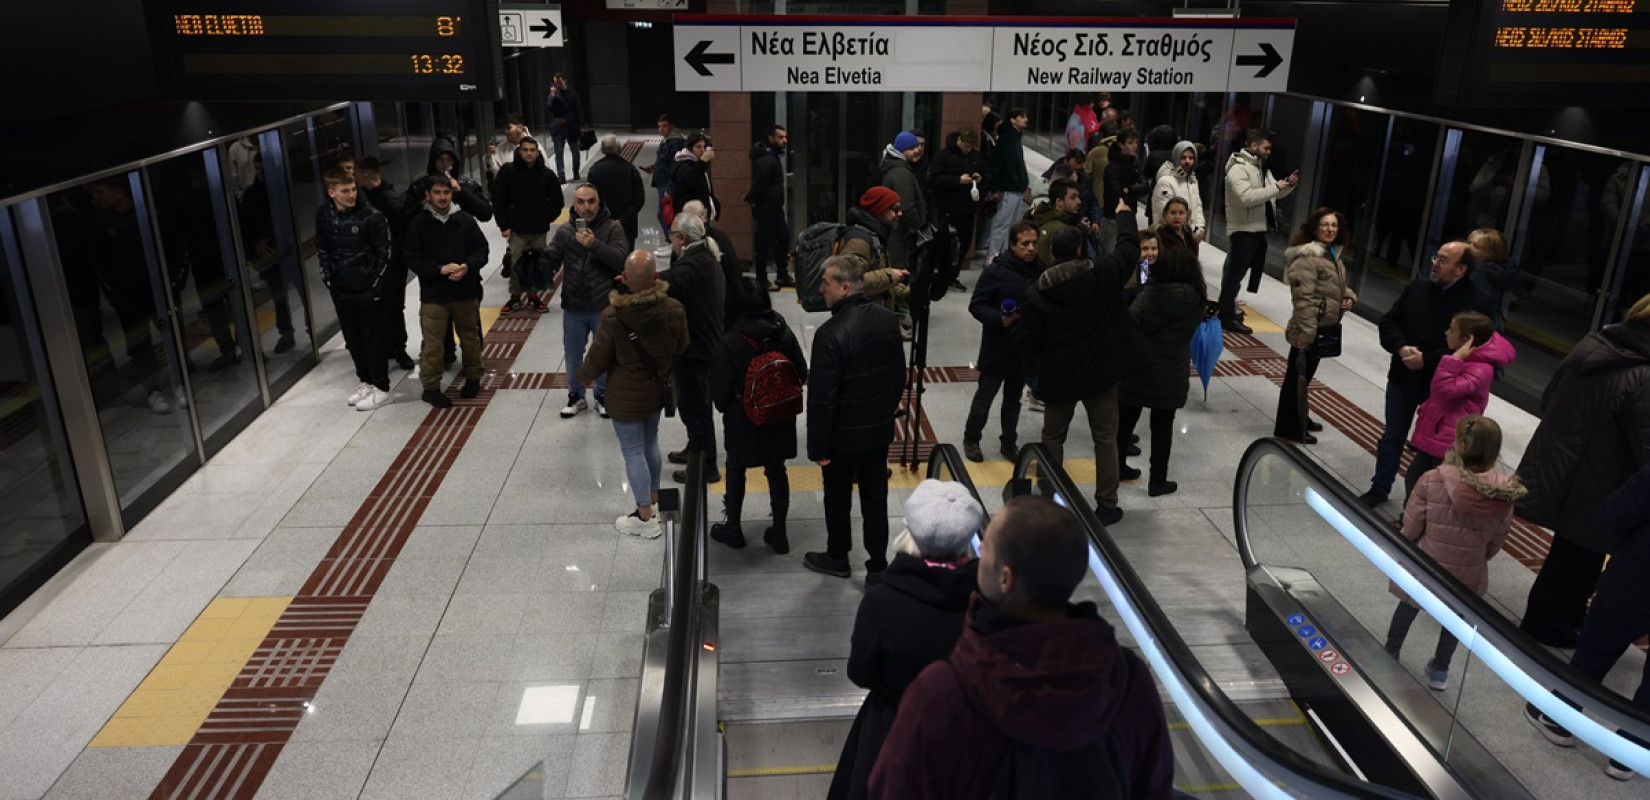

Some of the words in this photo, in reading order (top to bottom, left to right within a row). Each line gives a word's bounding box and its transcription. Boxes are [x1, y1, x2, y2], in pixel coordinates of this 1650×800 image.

[751, 30, 795, 56] Νέα
[802, 30, 890, 61] Ελβετία
[1014, 31, 1068, 61] Νέος
[1074, 32, 1114, 57] Σιδ.
[1121, 32, 1213, 62] Σταθμός
[410, 54, 463, 73] 13:32
[787, 66, 820, 85] Nea
[824, 66, 882, 85] Elvetia
[1027, 66, 1064, 85] New
[1068, 66, 1132, 89] Railway
[1136, 66, 1195, 86] Station
